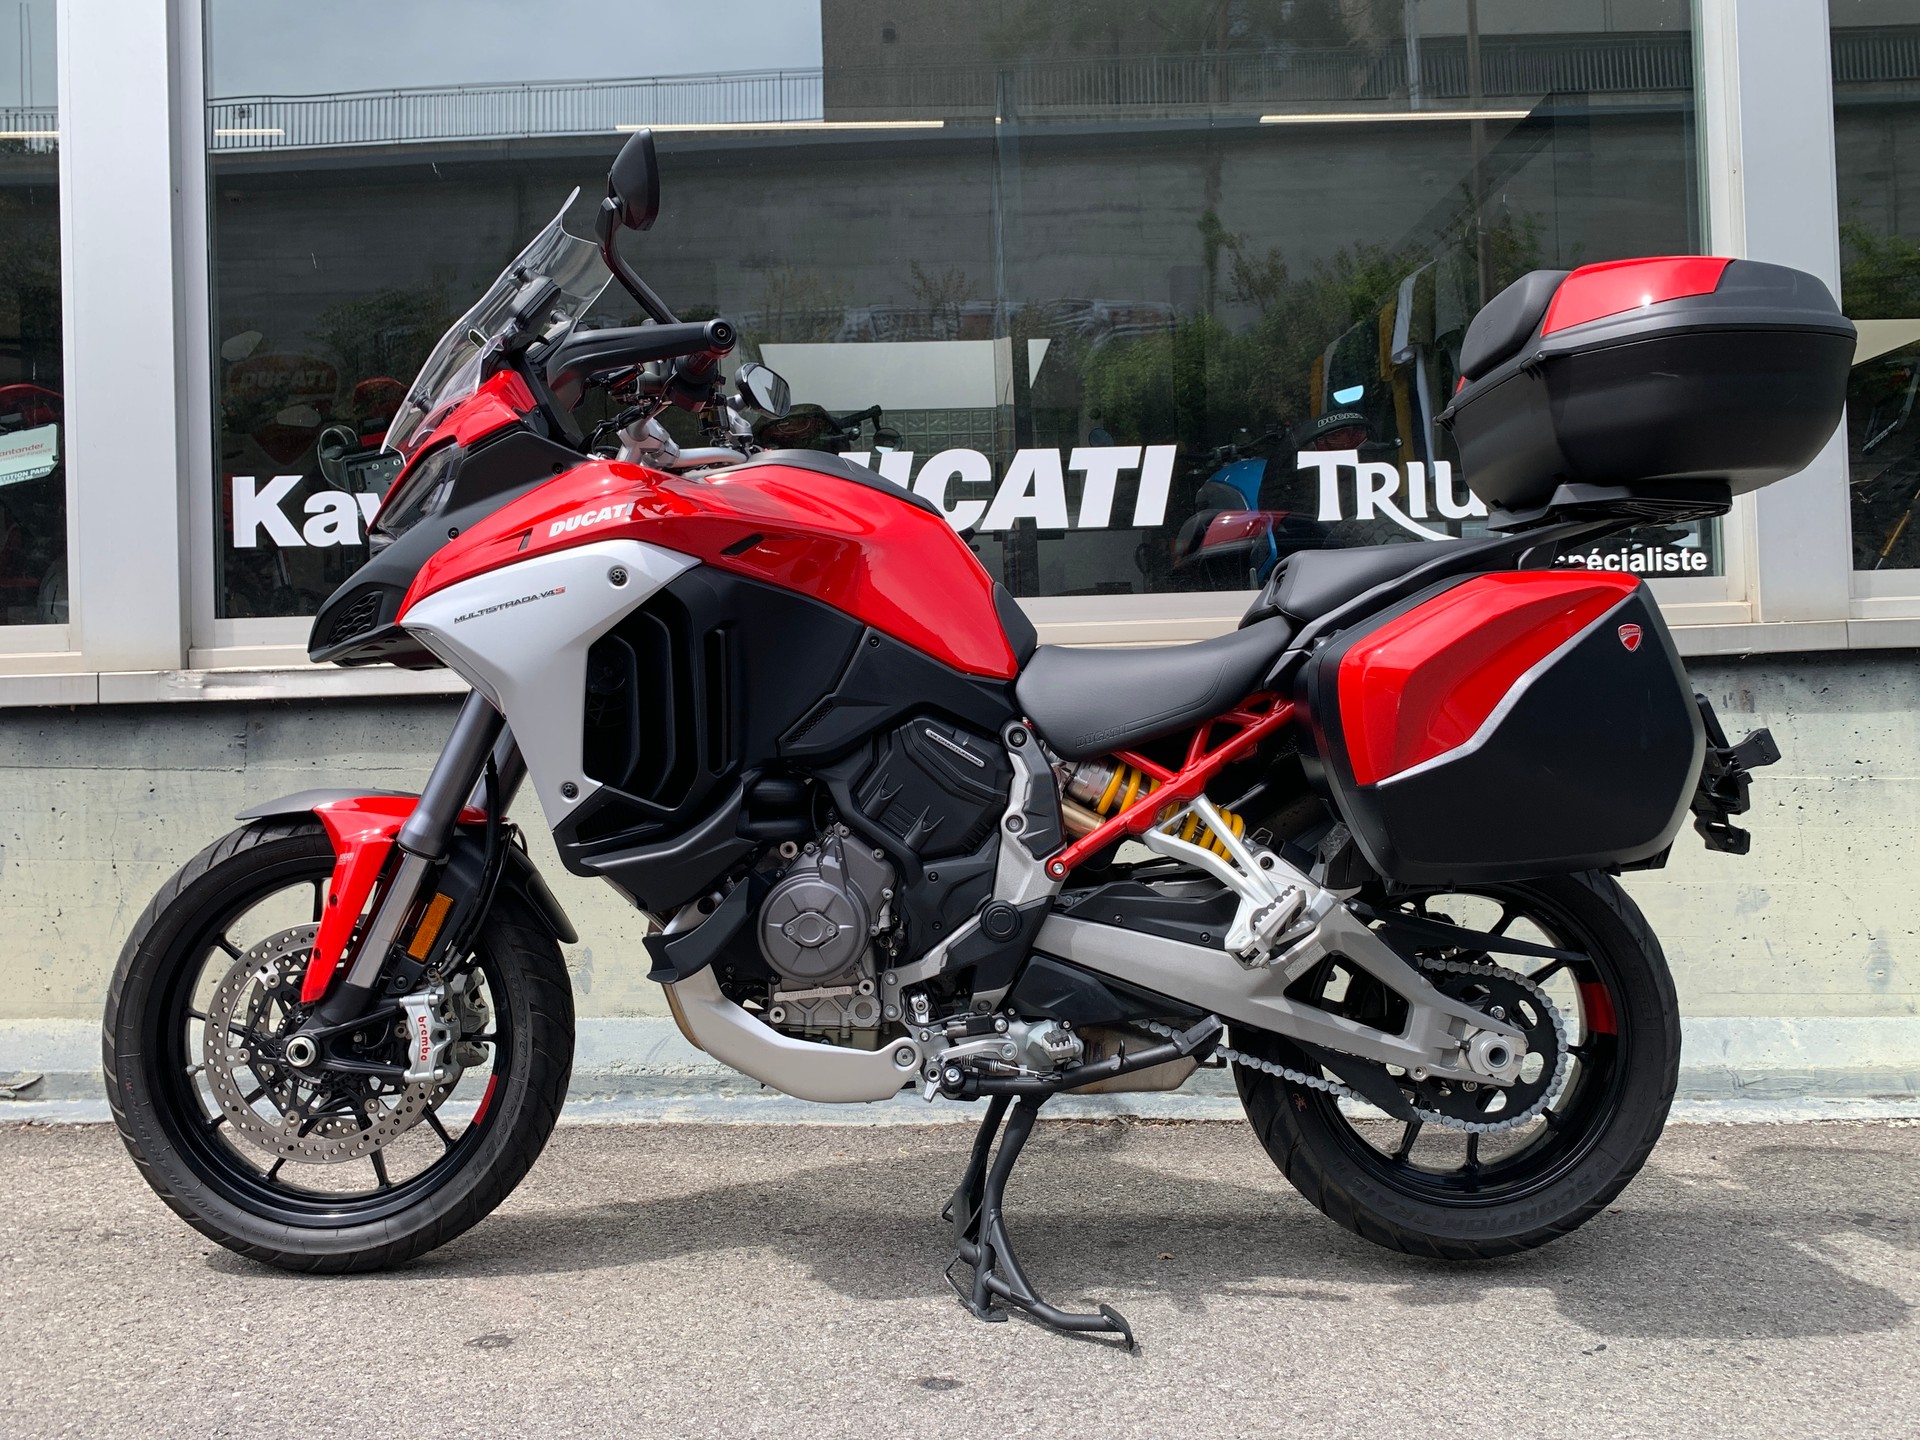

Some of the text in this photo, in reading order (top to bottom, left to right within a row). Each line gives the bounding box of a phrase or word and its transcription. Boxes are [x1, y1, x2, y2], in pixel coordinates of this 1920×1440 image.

[30, 466, 51, 475] PARK
[549, 502, 636, 538] DUCATI
[454, 595, 540, 624] MULTISTRADA
[1075, 723, 1128, 749] DUCATI
[417, 1015, 432, 1061] brembo
